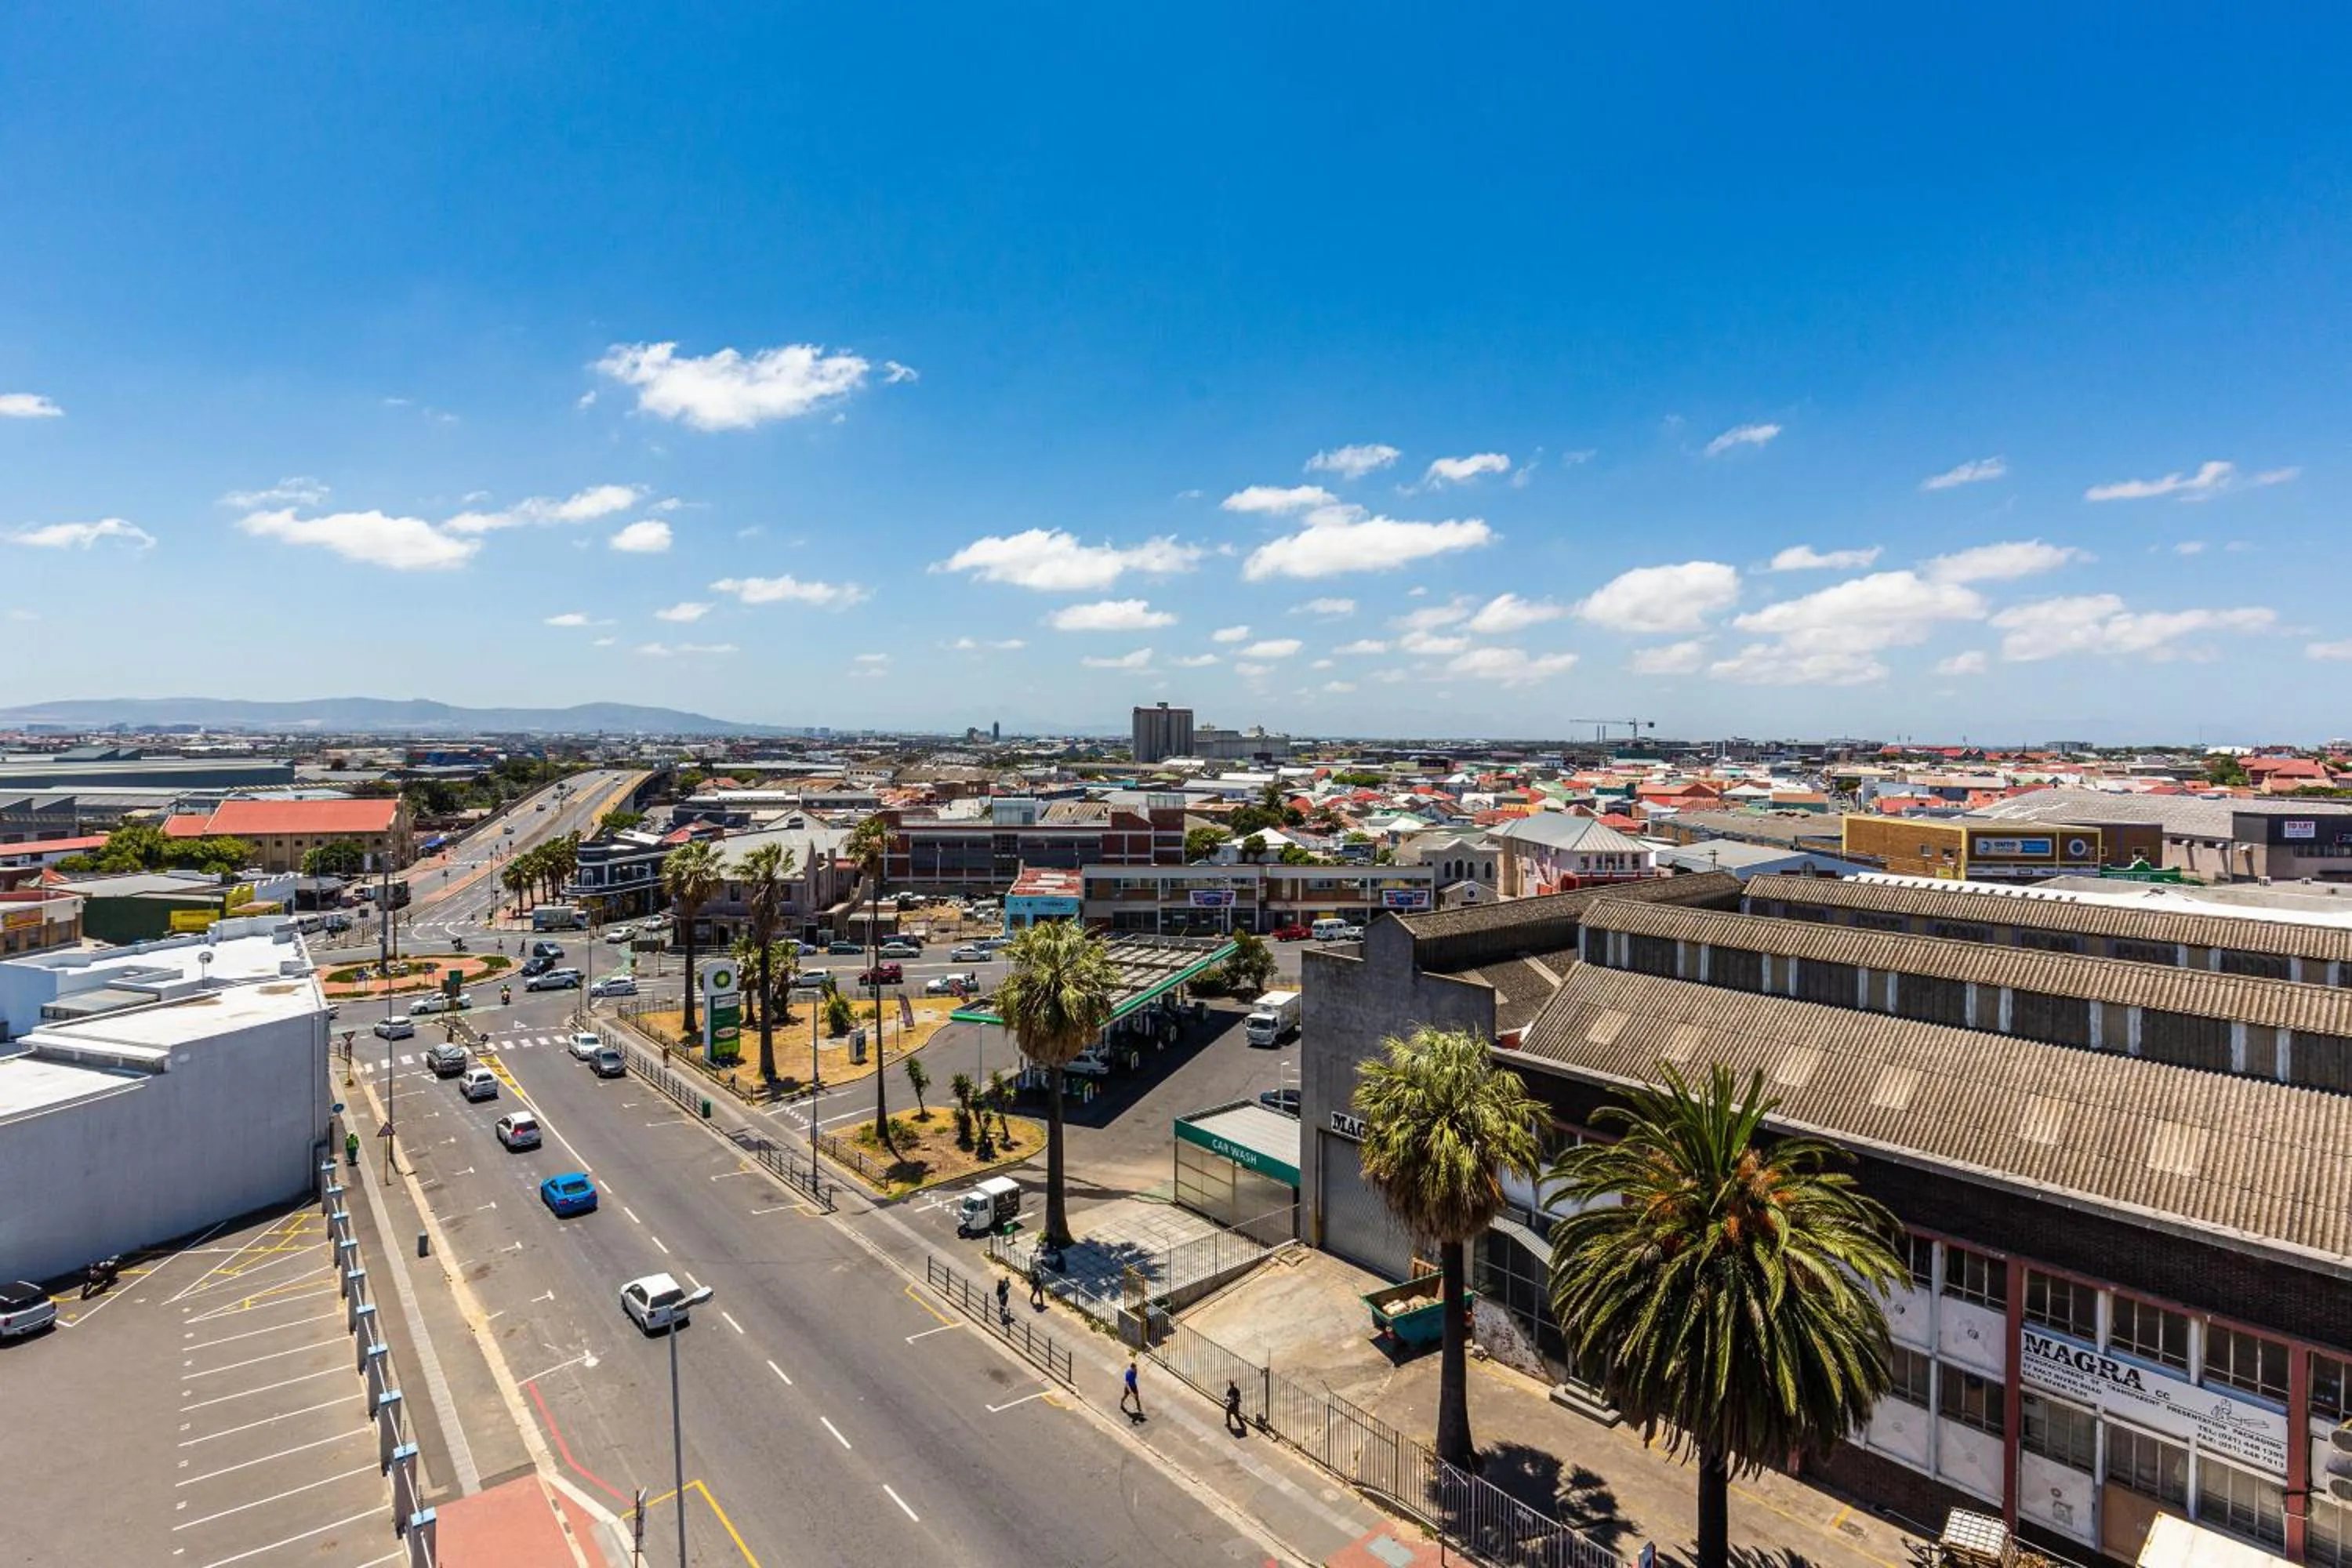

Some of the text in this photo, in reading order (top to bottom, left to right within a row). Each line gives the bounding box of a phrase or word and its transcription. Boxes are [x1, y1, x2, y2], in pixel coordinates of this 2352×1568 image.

[1211, 1138, 1257, 1166] CAR WASH
[2023, 1332, 2171, 1401] MAGRA CC
[2166, 1404, 2227, 1430] PRESENTATION
